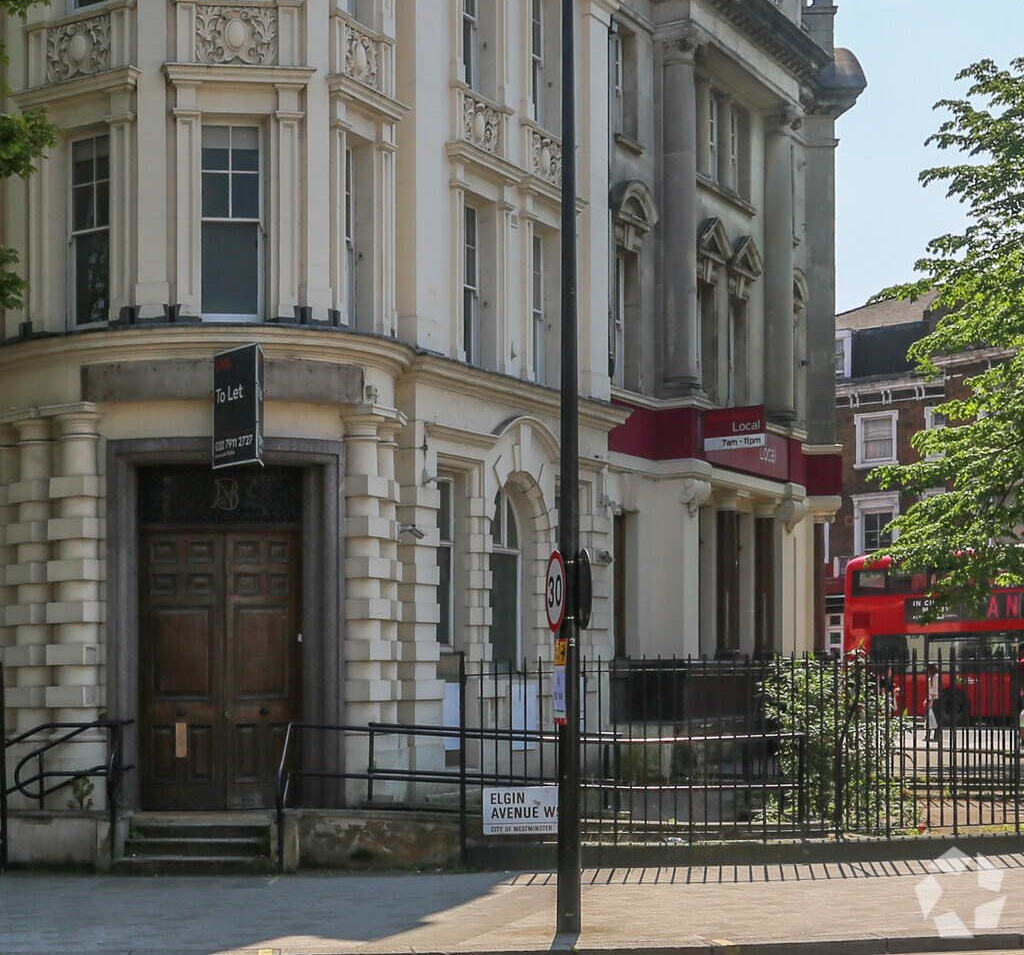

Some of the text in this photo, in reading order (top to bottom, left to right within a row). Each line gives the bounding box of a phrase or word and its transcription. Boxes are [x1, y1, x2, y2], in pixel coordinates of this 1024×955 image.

[215, 384, 243, 404] To Let
[732, 419, 761, 432] Local
[215, 440, 224, 452] 020
[225, 437, 237, 449] 7911
[238, 434, 253, 447] 2727
[743, 437, 761, 445] 11pm
[759, 446, 776, 463] Local
[548, 574, 562, 608] 30
[490, 792, 525, 805] ELGIN
[491, 806, 539, 819] AVENUE
[490, 825, 503, 833] CITY
